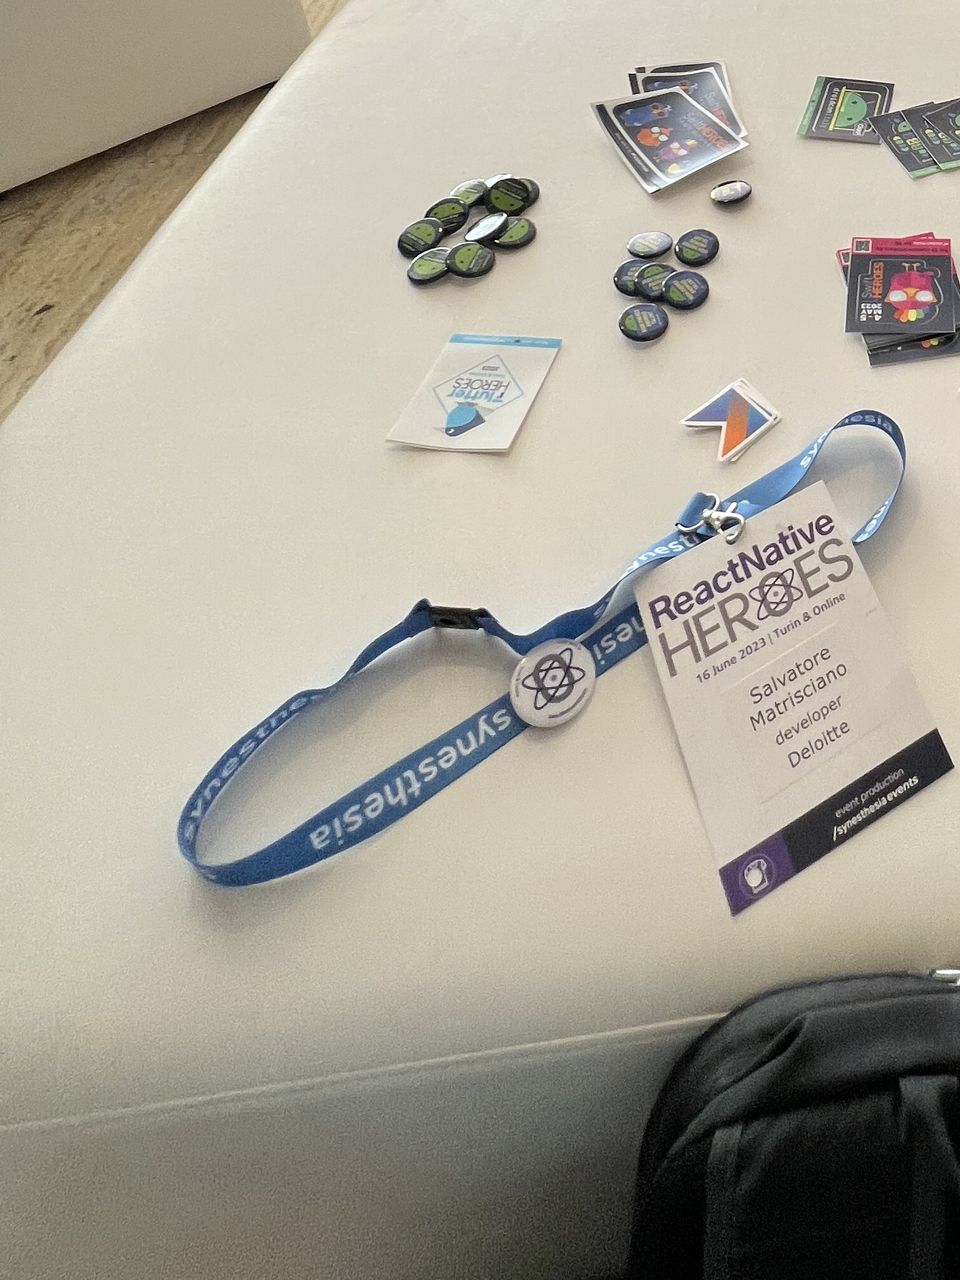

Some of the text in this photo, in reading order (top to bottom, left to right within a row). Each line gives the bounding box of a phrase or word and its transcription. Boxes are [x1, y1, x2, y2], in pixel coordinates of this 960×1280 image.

[452, 377, 510, 391] HEROES
[648, 514, 836, 630] ReactNative
[658, 537, 855, 678] HEROES
[696, 670, 711, 683] 16
[712, 656, 738, 677] June
[739, 637, 768, 660] 2023
[773, 619, 801, 639] Turin
[803, 610, 812, 622] &
[812, 592, 846, 616] Online
[749, 647, 832, 704] Salvatore
[749, 663, 847, 732] Matrisciano
[775, 695, 842, 746] developer
[787, 721, 850, 768] Deloitte
[309, 708, 512, 851] synesthesia
[835, 768, 905, 818] event production
